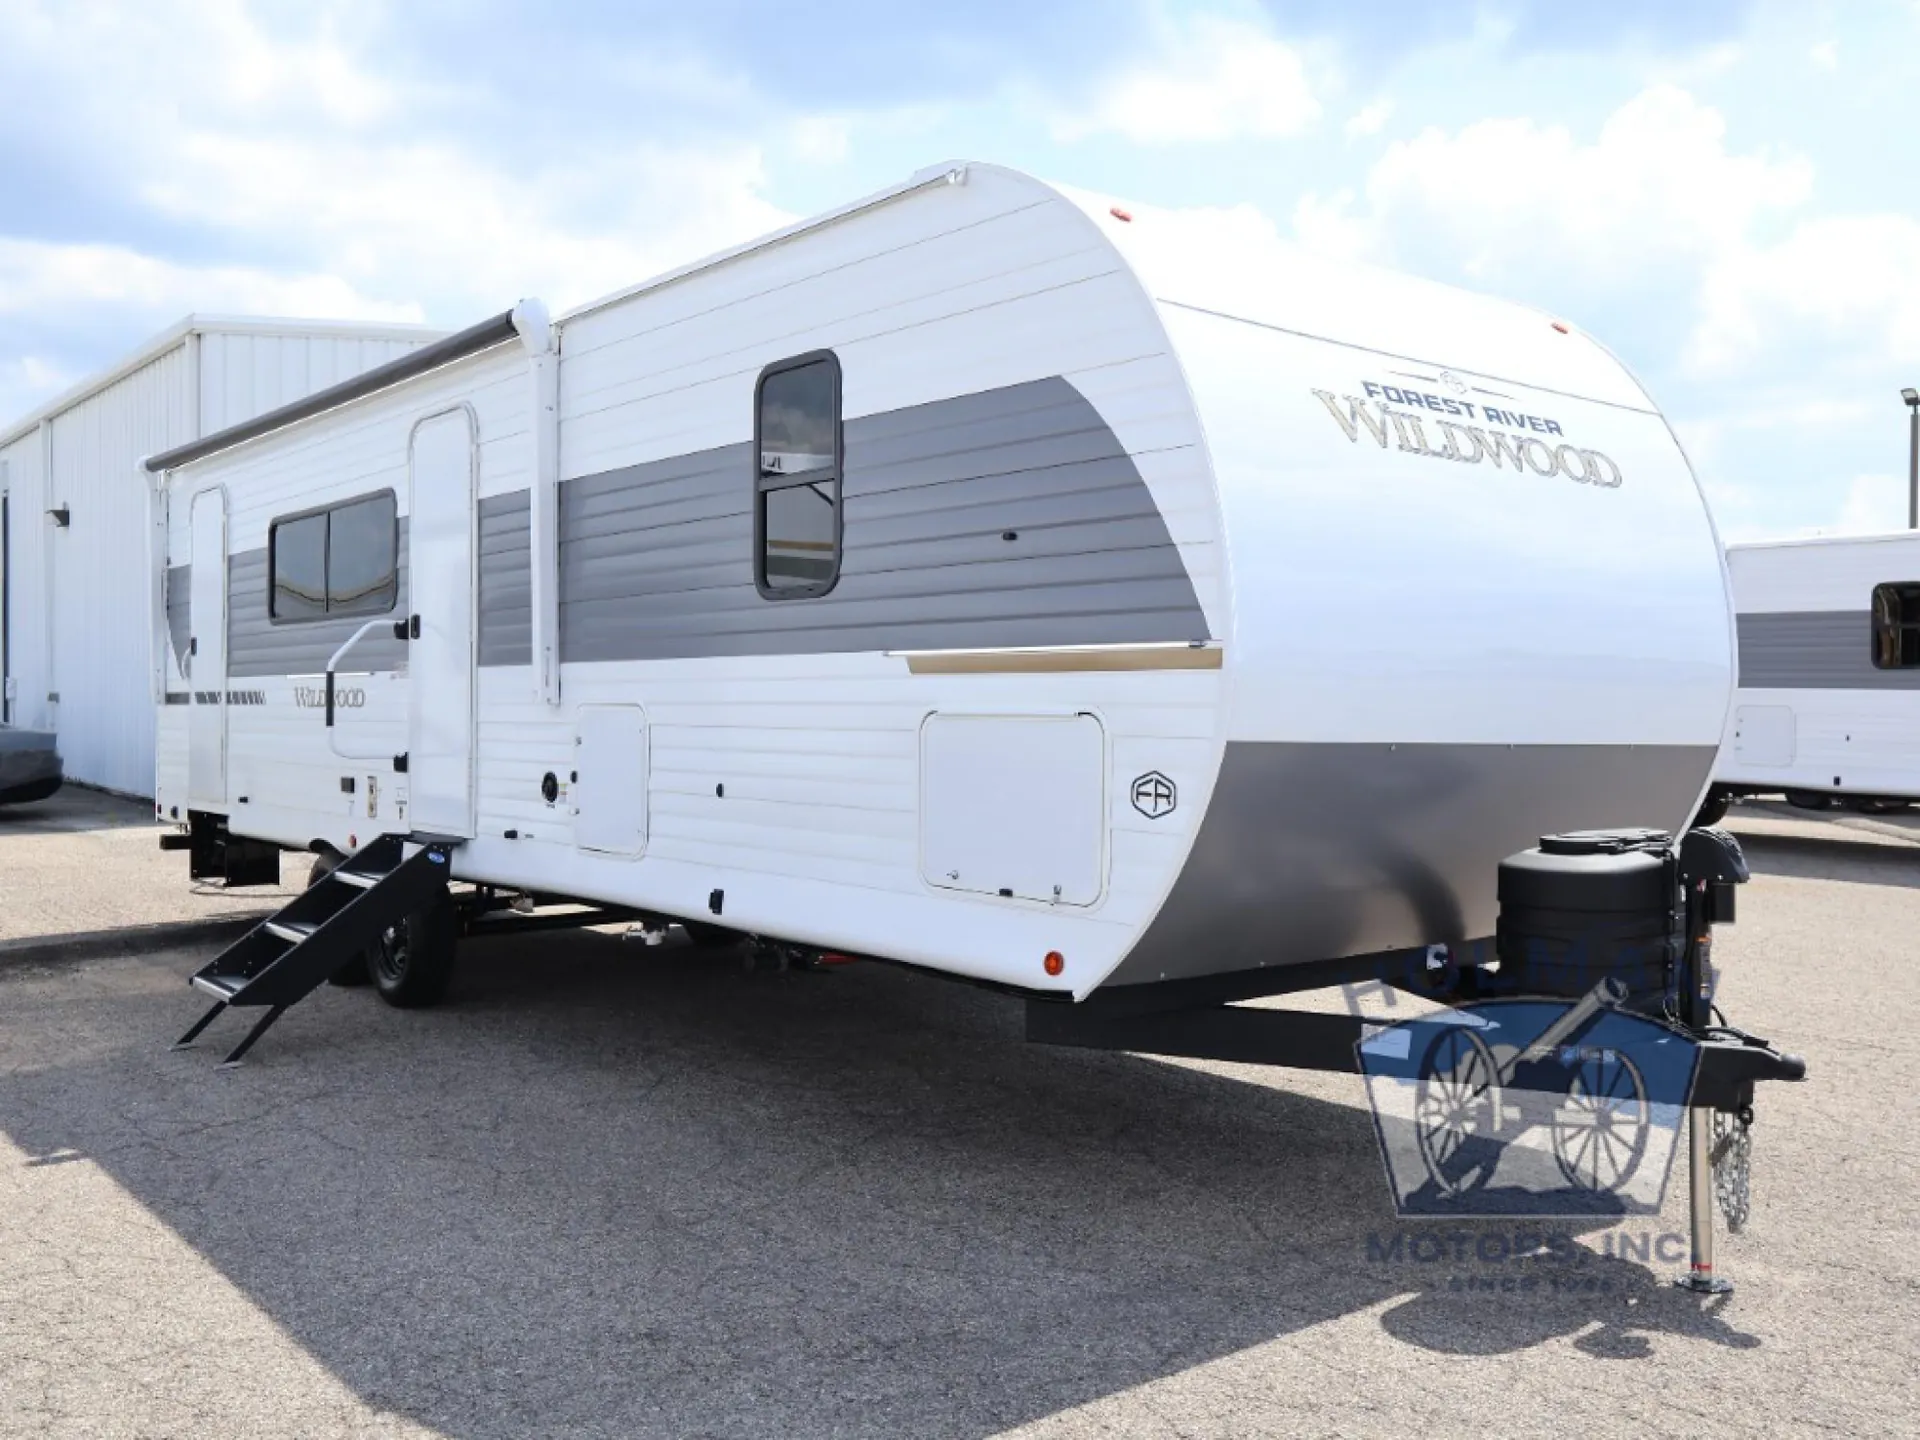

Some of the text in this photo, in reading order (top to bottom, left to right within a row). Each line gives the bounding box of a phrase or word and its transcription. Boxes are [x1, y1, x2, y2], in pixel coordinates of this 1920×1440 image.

[1311, 388, 1623, 489] WILDWOOD
[1361, 380, 1564, 437] FOREST RIVER
